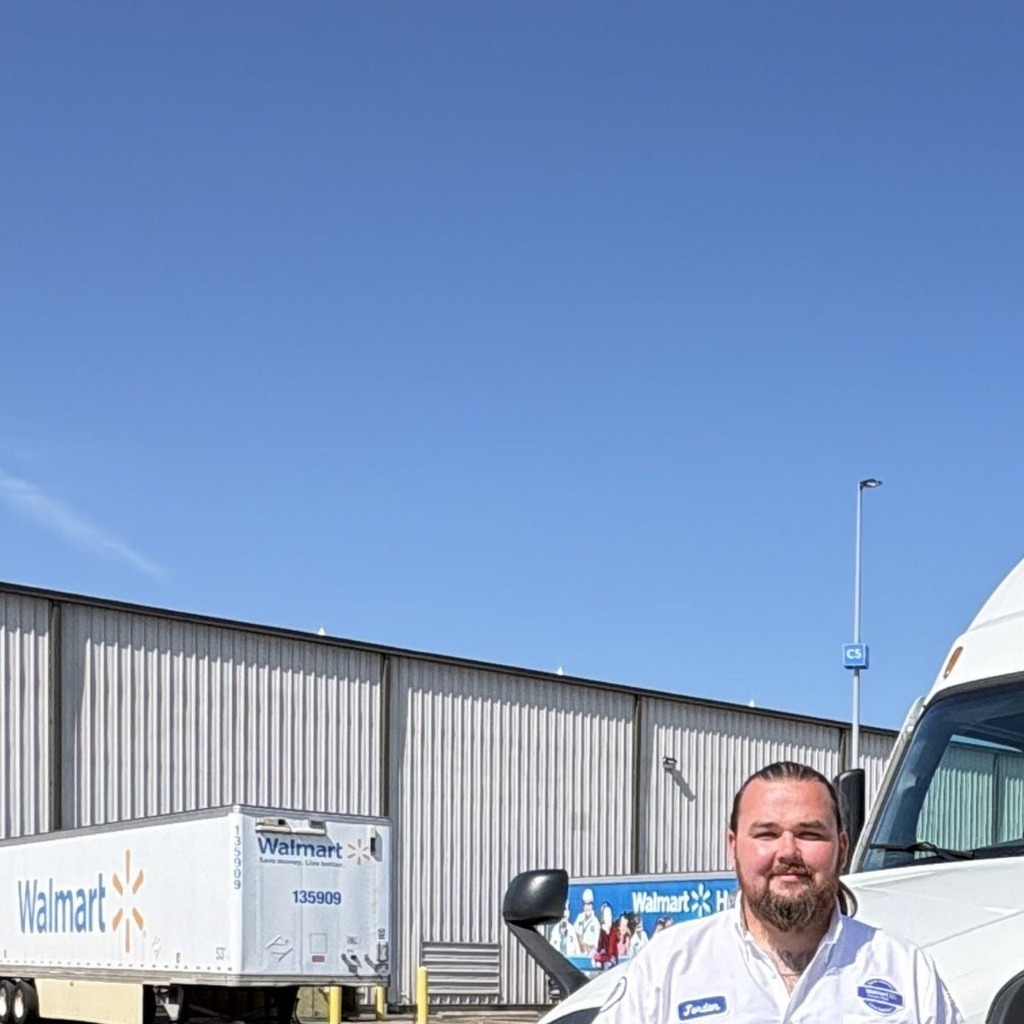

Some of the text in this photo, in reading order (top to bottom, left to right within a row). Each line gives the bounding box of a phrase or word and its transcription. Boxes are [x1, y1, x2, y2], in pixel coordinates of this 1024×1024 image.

[258, 836, 343, 859] Walmart
[18, 873, 106, 934] Walmart
[292, 890, 342, 905] 135909
[632, 891, 690, 914] Walmart
